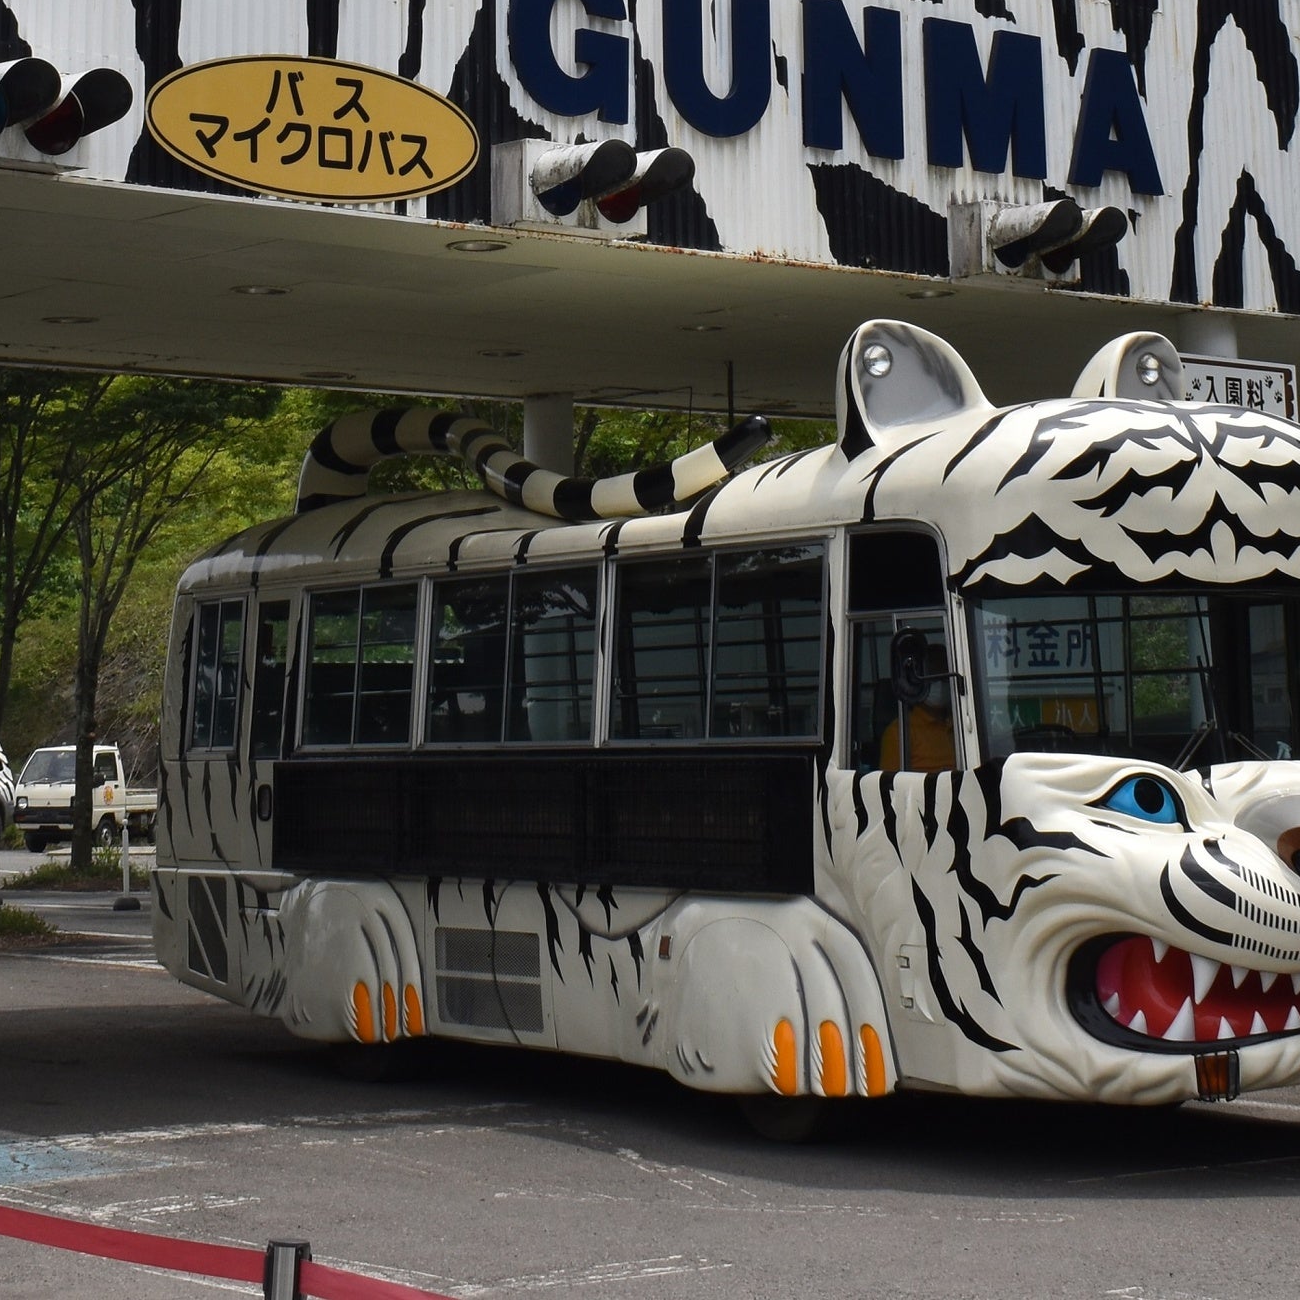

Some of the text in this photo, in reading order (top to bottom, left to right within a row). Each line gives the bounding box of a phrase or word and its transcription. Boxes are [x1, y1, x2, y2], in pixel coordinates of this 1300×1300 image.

[265, 69, 370, 123] バス
[189, 112, 434, 179] マイクロバス
[1206, 375, 1265, 411] 入園料
